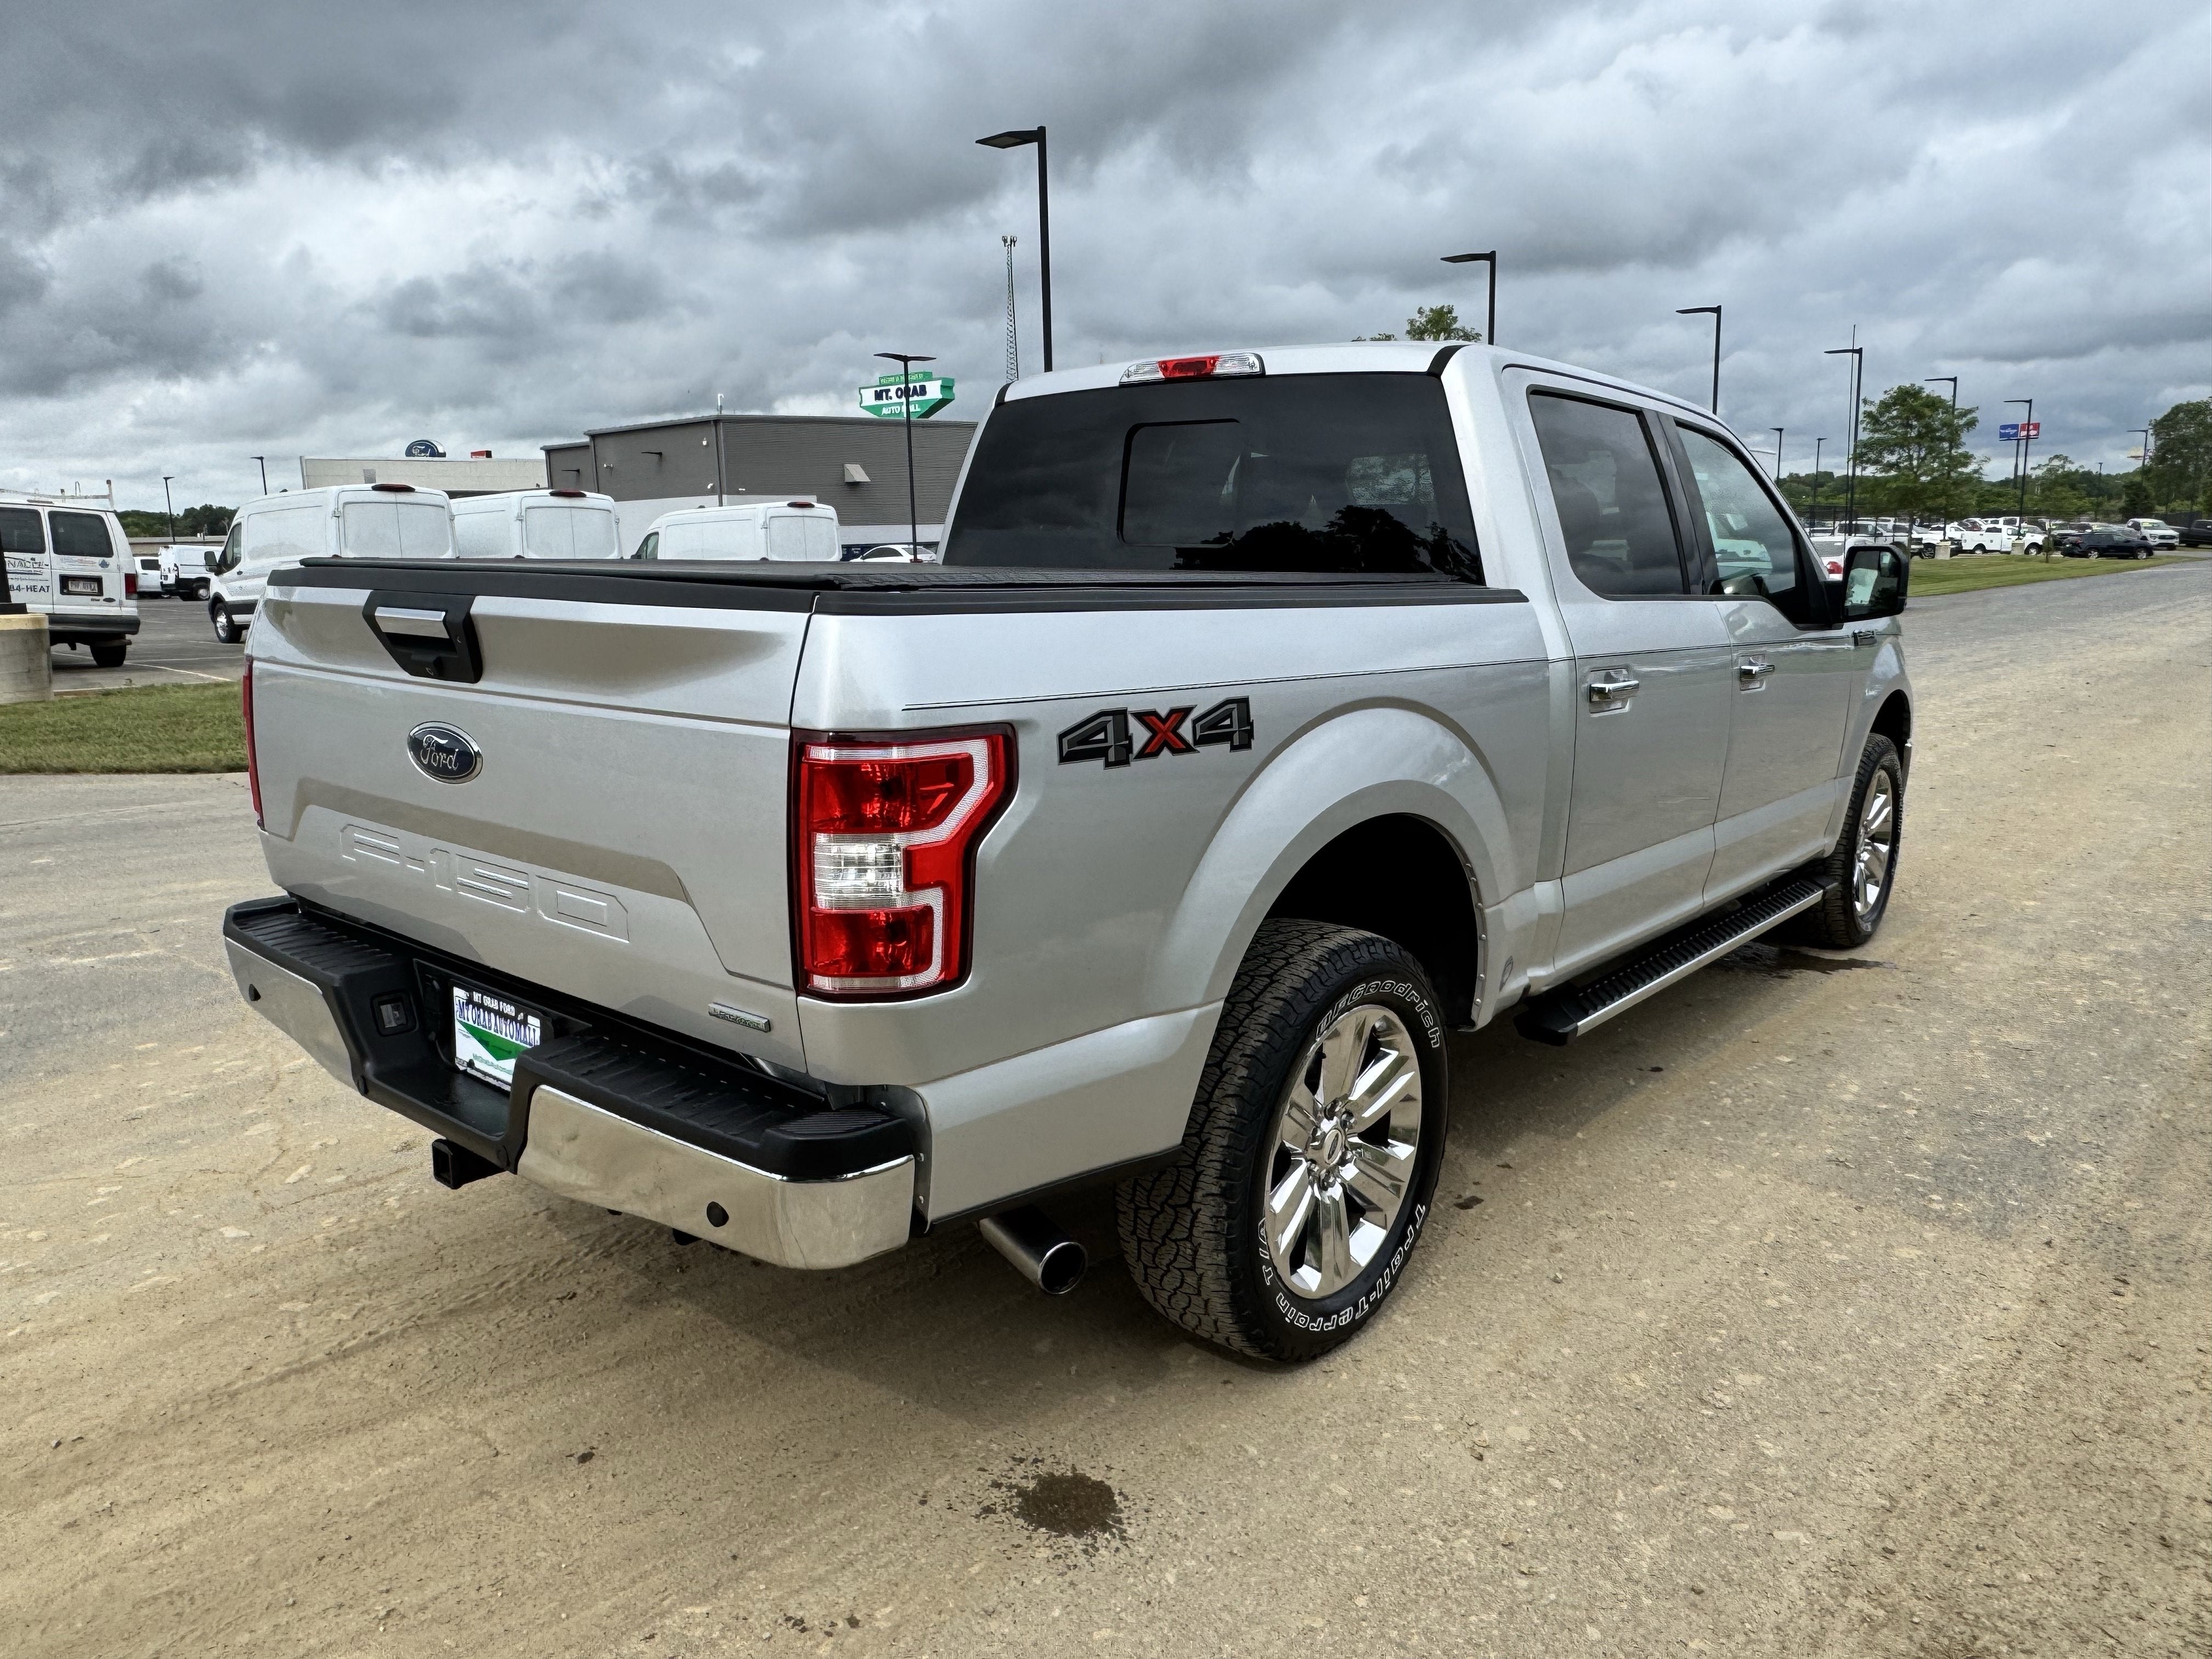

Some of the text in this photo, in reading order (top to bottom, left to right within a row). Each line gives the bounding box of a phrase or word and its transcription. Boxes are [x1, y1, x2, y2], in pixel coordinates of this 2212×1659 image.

[874, 389, 893, 401] MT.
[420, 734, 459, 771] Ford
[340, 823, 629, 944] F-150
